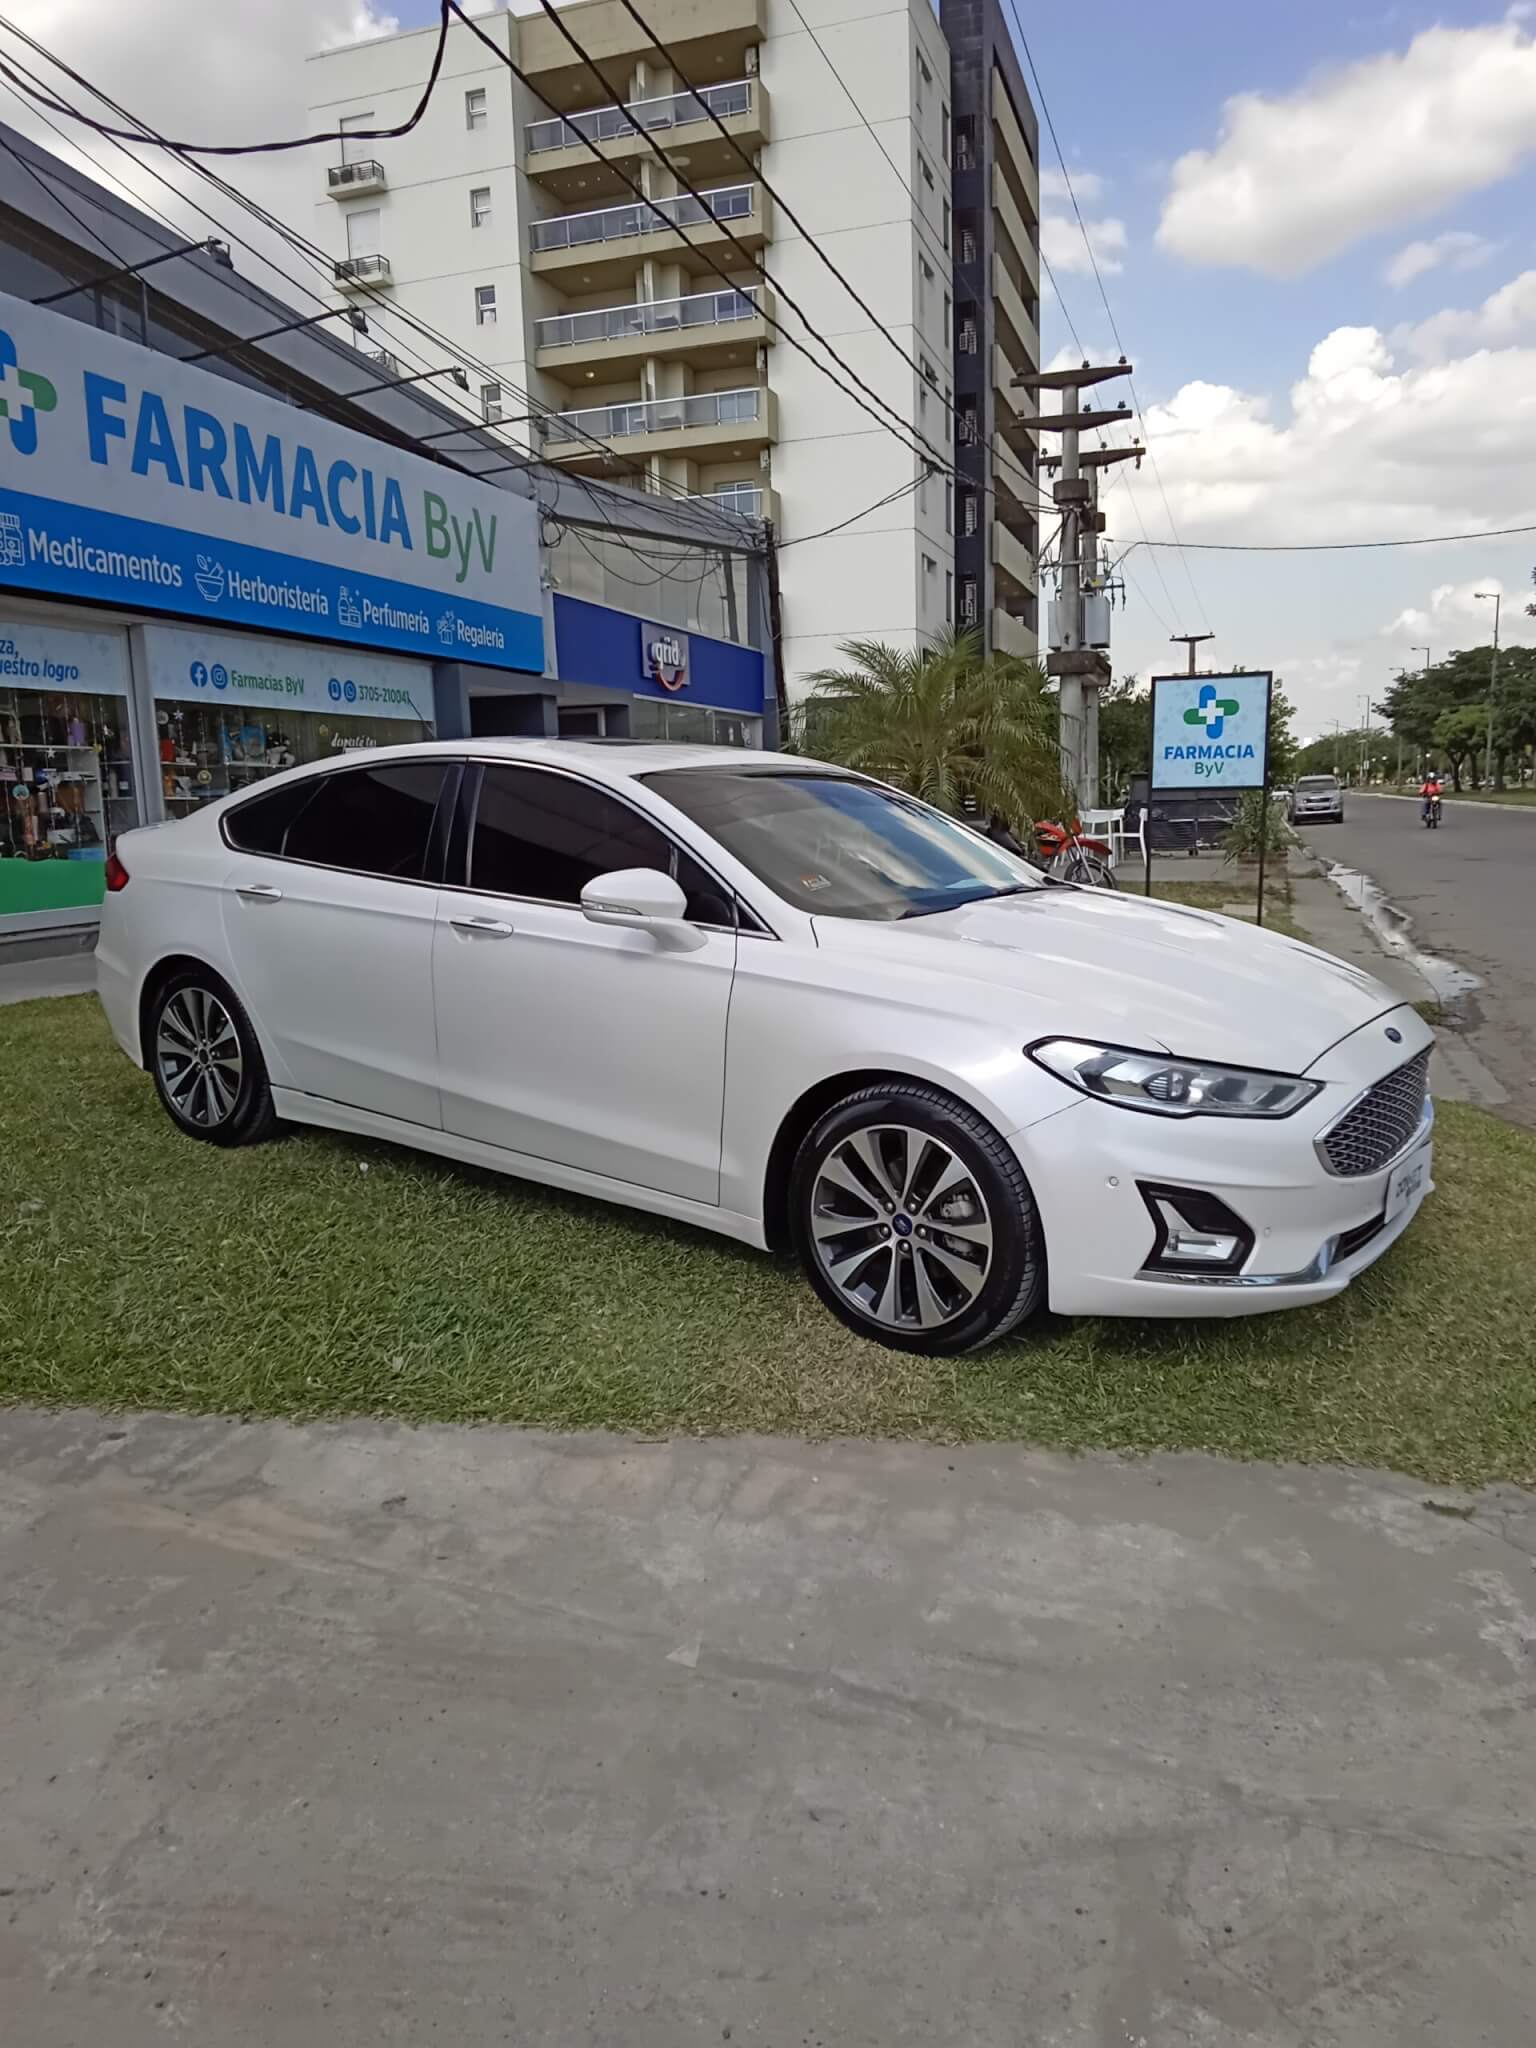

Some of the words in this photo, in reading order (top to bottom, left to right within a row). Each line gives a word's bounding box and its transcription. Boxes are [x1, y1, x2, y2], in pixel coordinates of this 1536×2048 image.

[83, 370, 413, 551] FARMACIA
[423, 490, 497, 583] ByV
[28, 528, 183, 587] Medicamentos
[227, 569, 329, 615] Herboristería
[363, 598, 430, 634] Perfumería
[457, 619, 505, 649] Regalería
[43, 659, 79, 682] logro
[231, 670, 283, 692] Farmacias
[285, 676, 304, 696] ByV
[1164, 744, 1255, 760] FARMACIA
[1194, 761, 1225, 777] ByV
